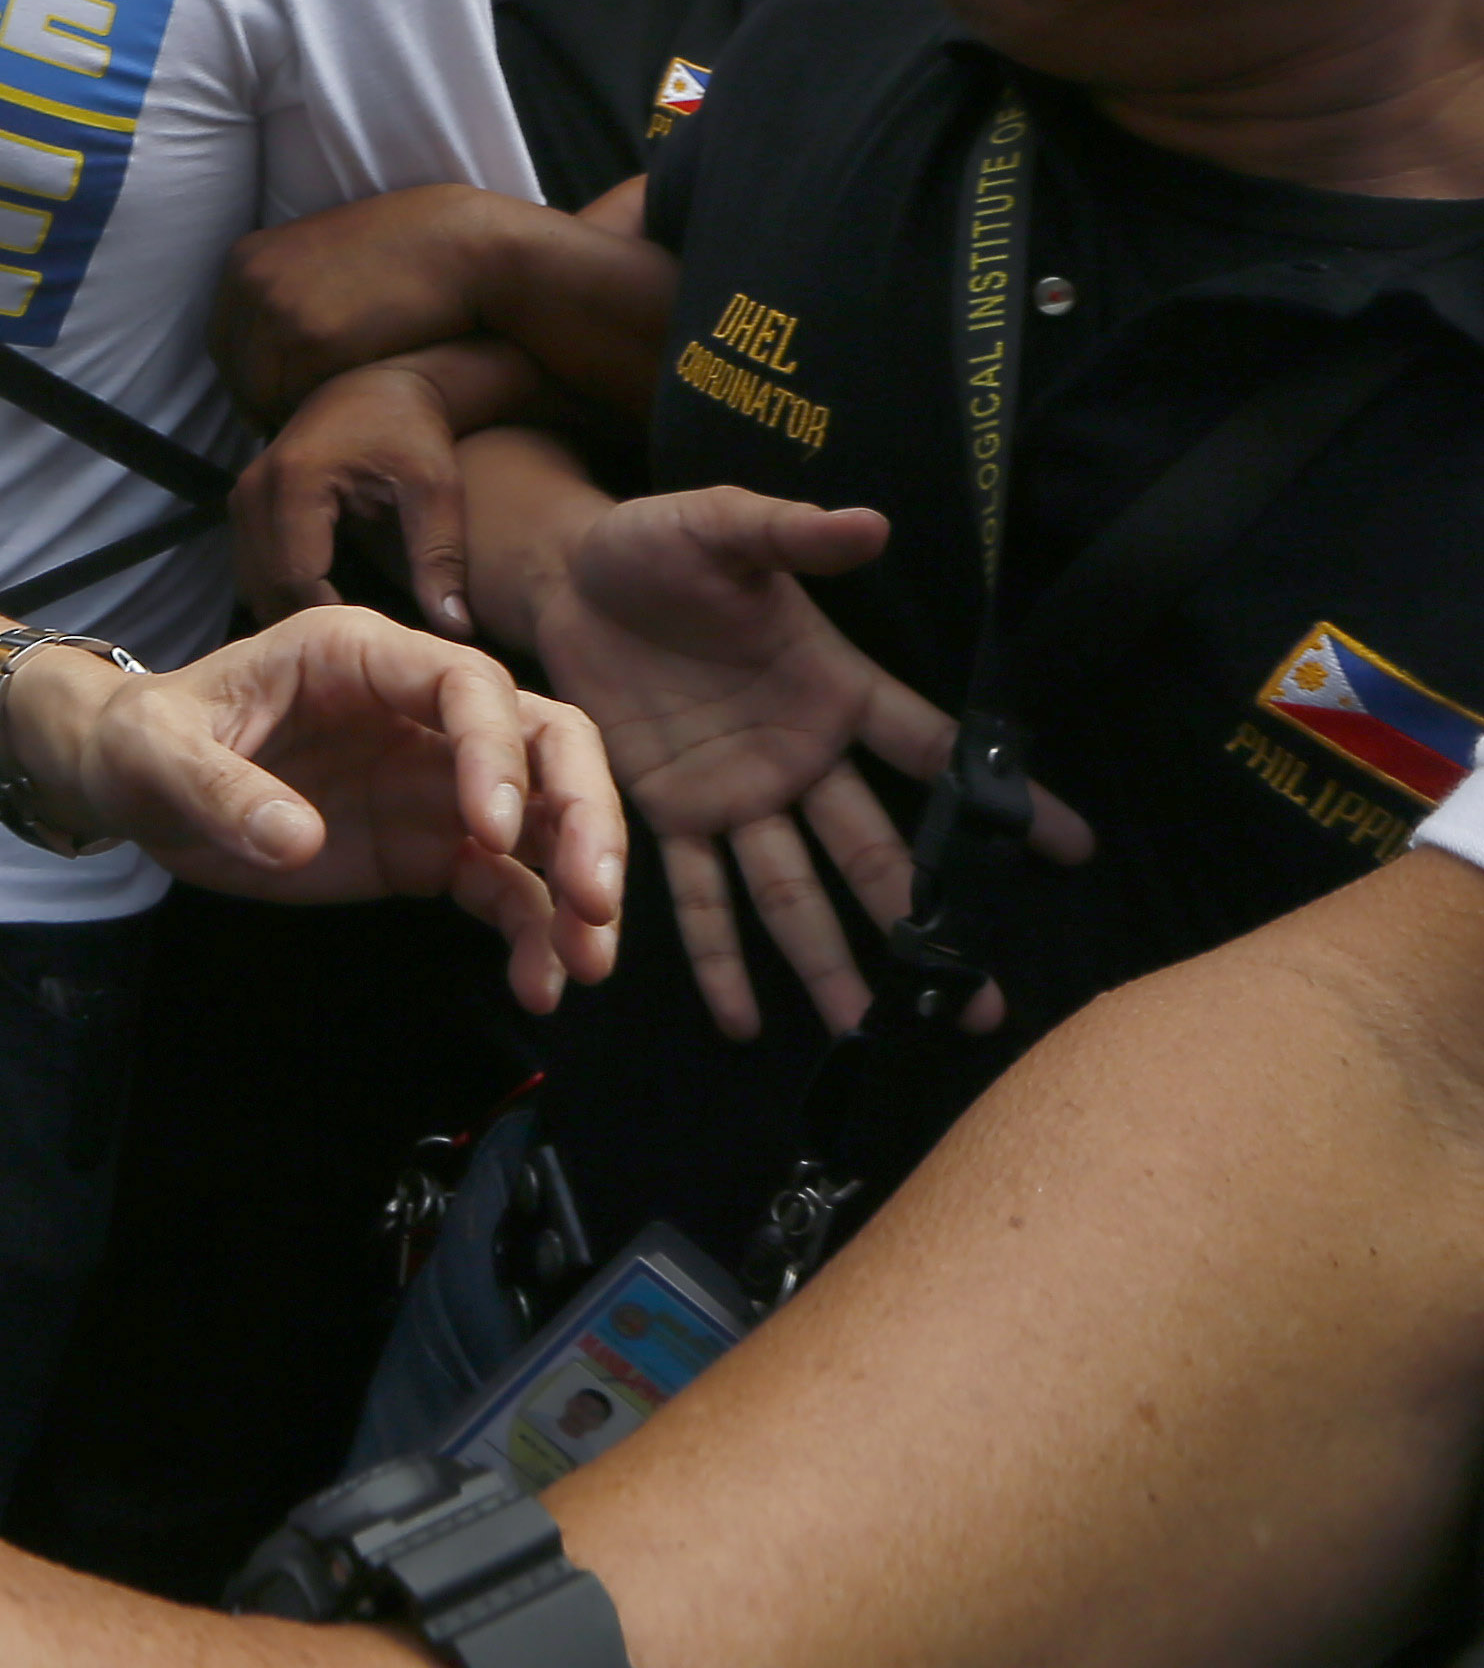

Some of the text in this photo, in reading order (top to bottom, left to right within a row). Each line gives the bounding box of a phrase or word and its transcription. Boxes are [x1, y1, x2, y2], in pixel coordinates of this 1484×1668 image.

[967, 151, 1022, 331] INSTITUTE
[712, 292, 799, 375] DHEL
[1224, 722, 1412, 860] PHILIPPI
